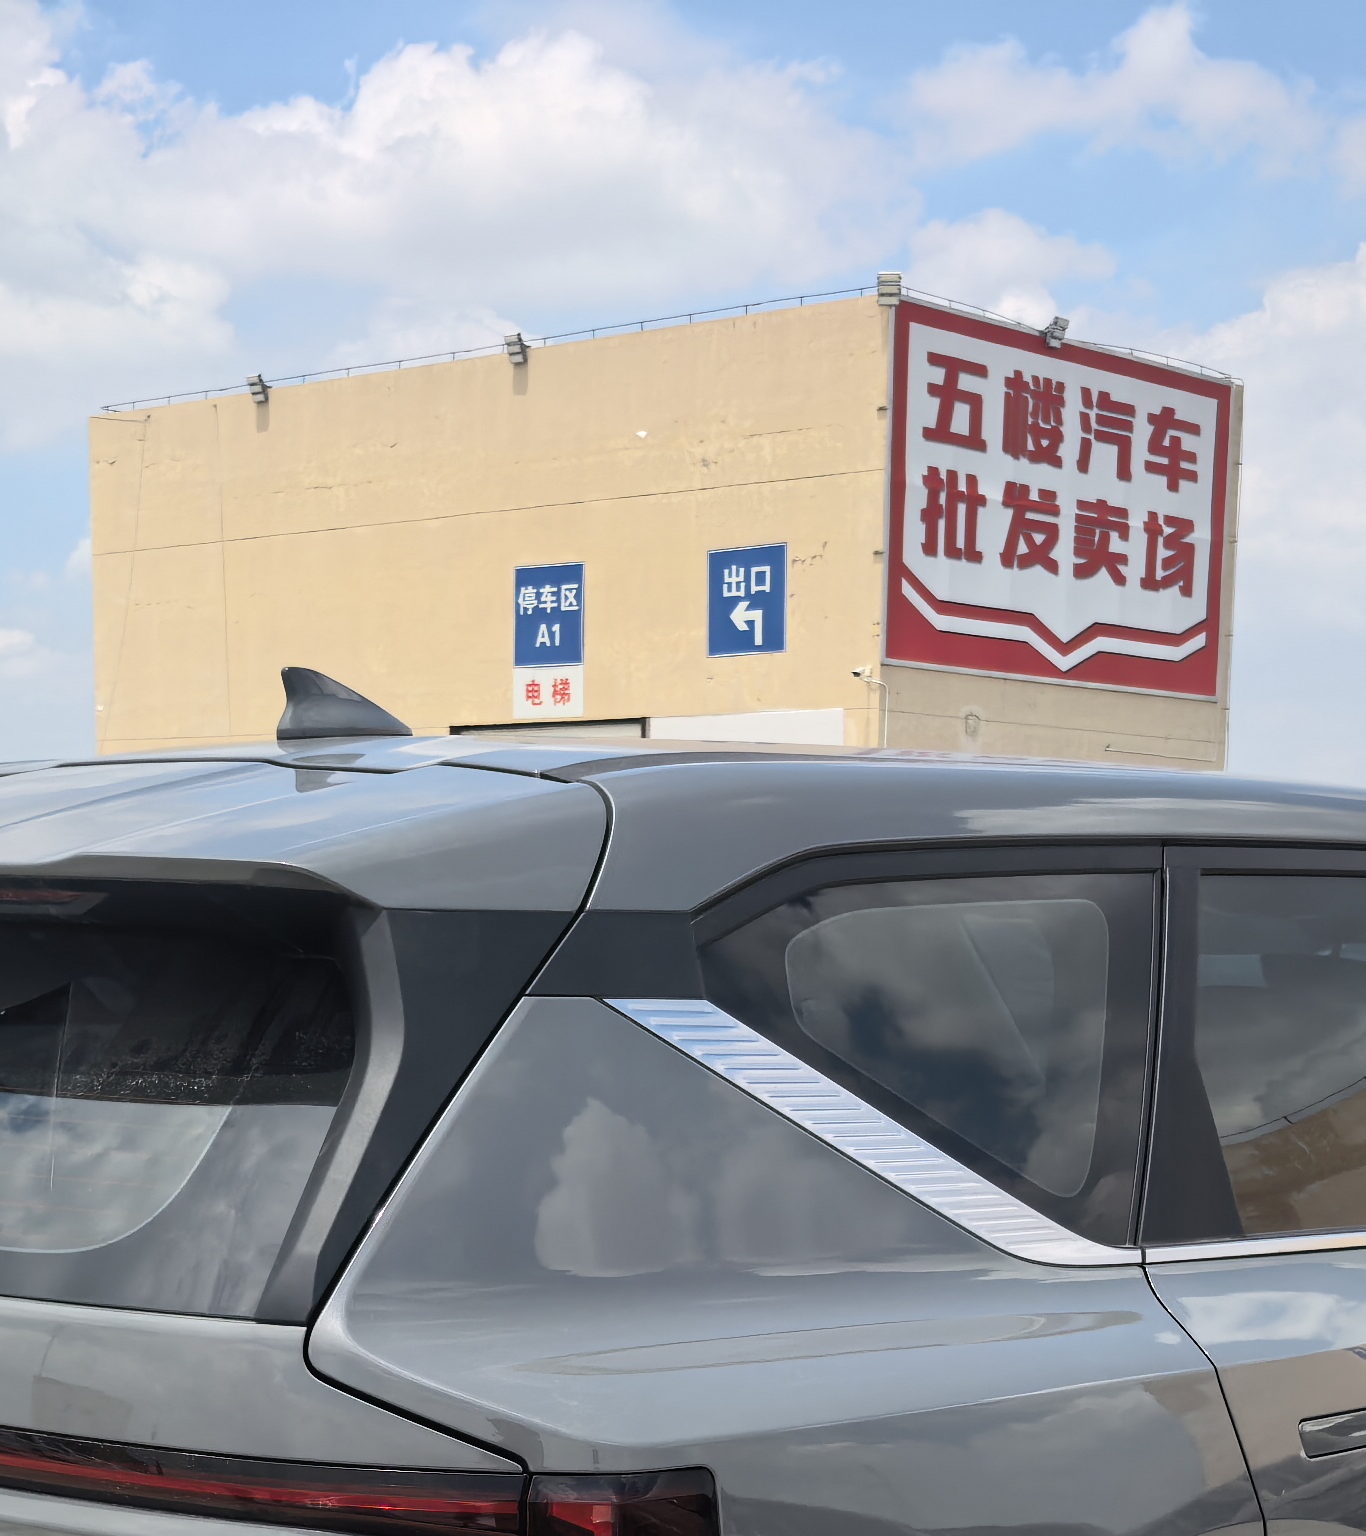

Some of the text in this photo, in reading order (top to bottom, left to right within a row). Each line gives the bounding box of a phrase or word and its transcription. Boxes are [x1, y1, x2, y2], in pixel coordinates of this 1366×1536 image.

[922, 351, 1201, 493] 五楼汽车
[920, 465, 1196, 598] 批发卖场
[722, 565, 771, 598] 出口
[517, 584, 580, 616] 停车区
[535, 623, 561, 648] A1
[525, 677, 572, 706] 电梯
